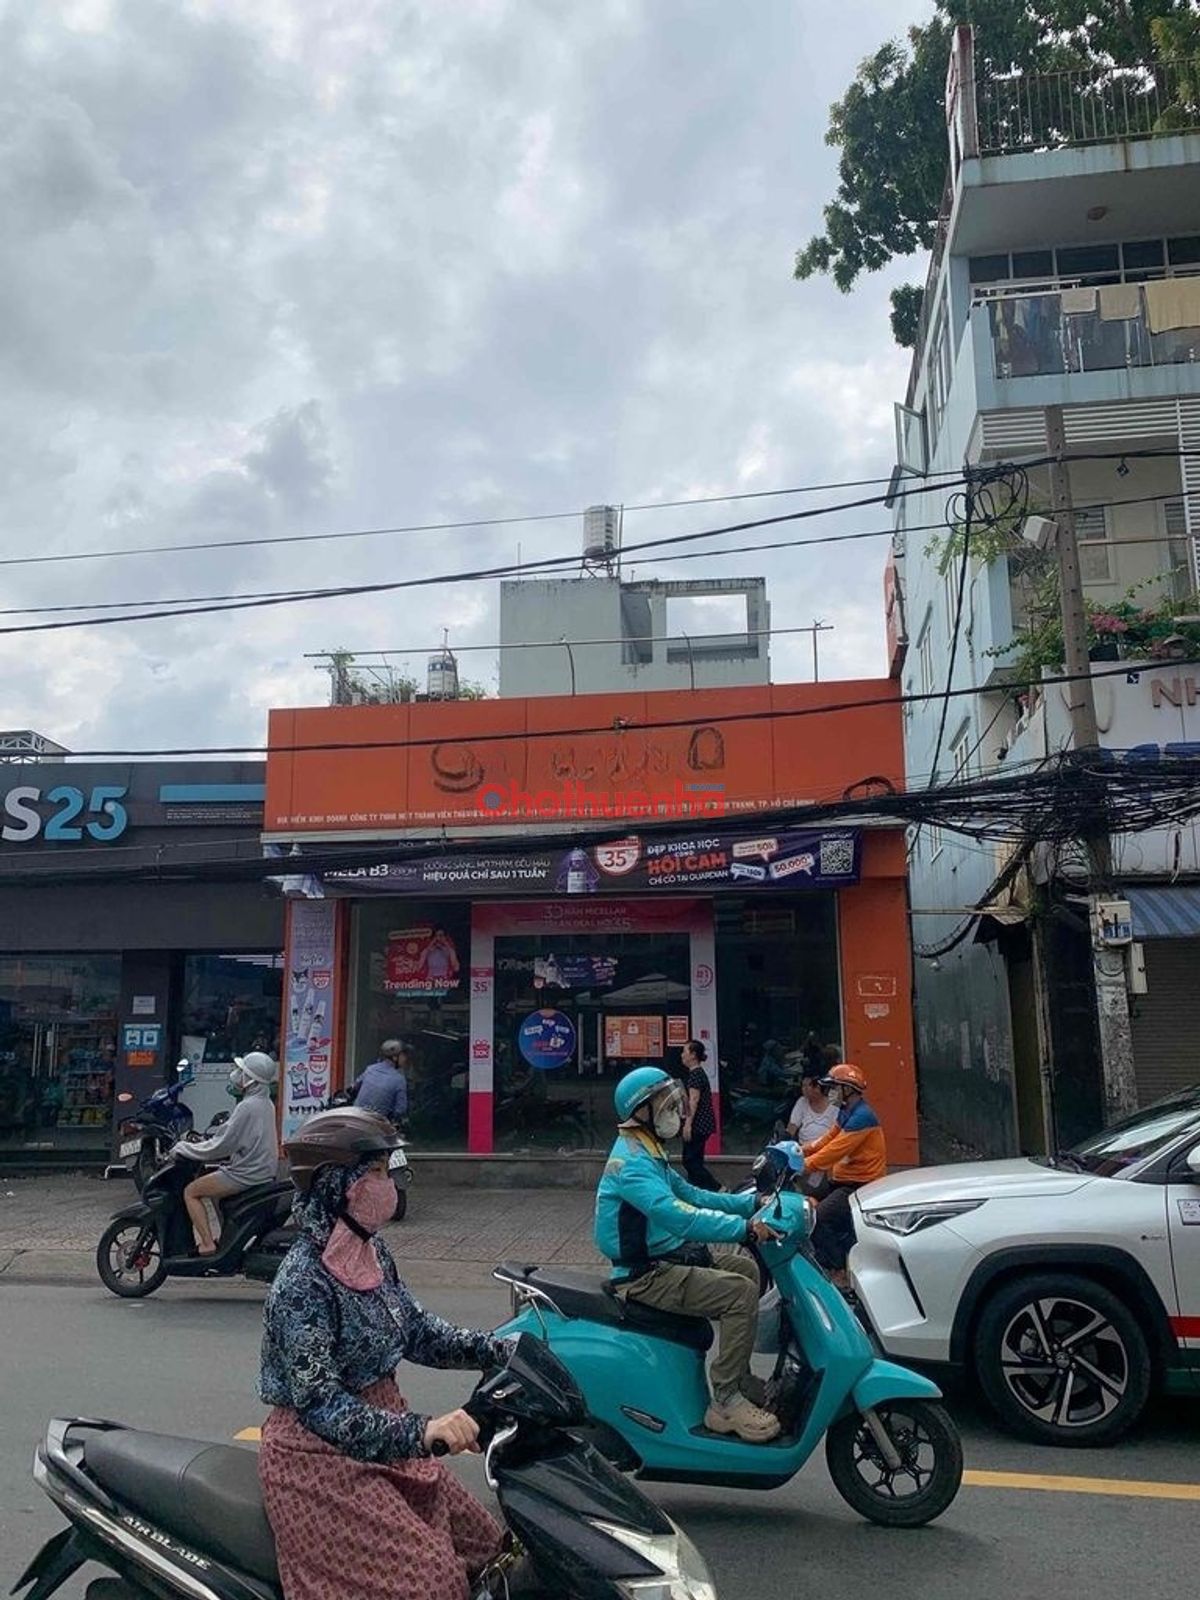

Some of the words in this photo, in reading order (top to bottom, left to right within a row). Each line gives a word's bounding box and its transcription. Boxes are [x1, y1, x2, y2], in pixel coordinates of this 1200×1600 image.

[2, 785, 128, 842] S25
[350, 812, 368, 821] CÔNG
[369, 813, 377, 821] TY
[668, 841, 696, 852] KHOA
[604, 851, 627, 867] 35
[685, 851, 726, 870] CAM
[423, 870, 447, 882] HIỆU
[448, 868, 470, 882] QUẢ
[490, 870, 510, 879] SAU
[384, 980, 432, 991] Trending
[435, 978, 459, 988] Now
[124, 1516, 151, 1536] AIR
[150, 1530, 211, 1570] BLADE
